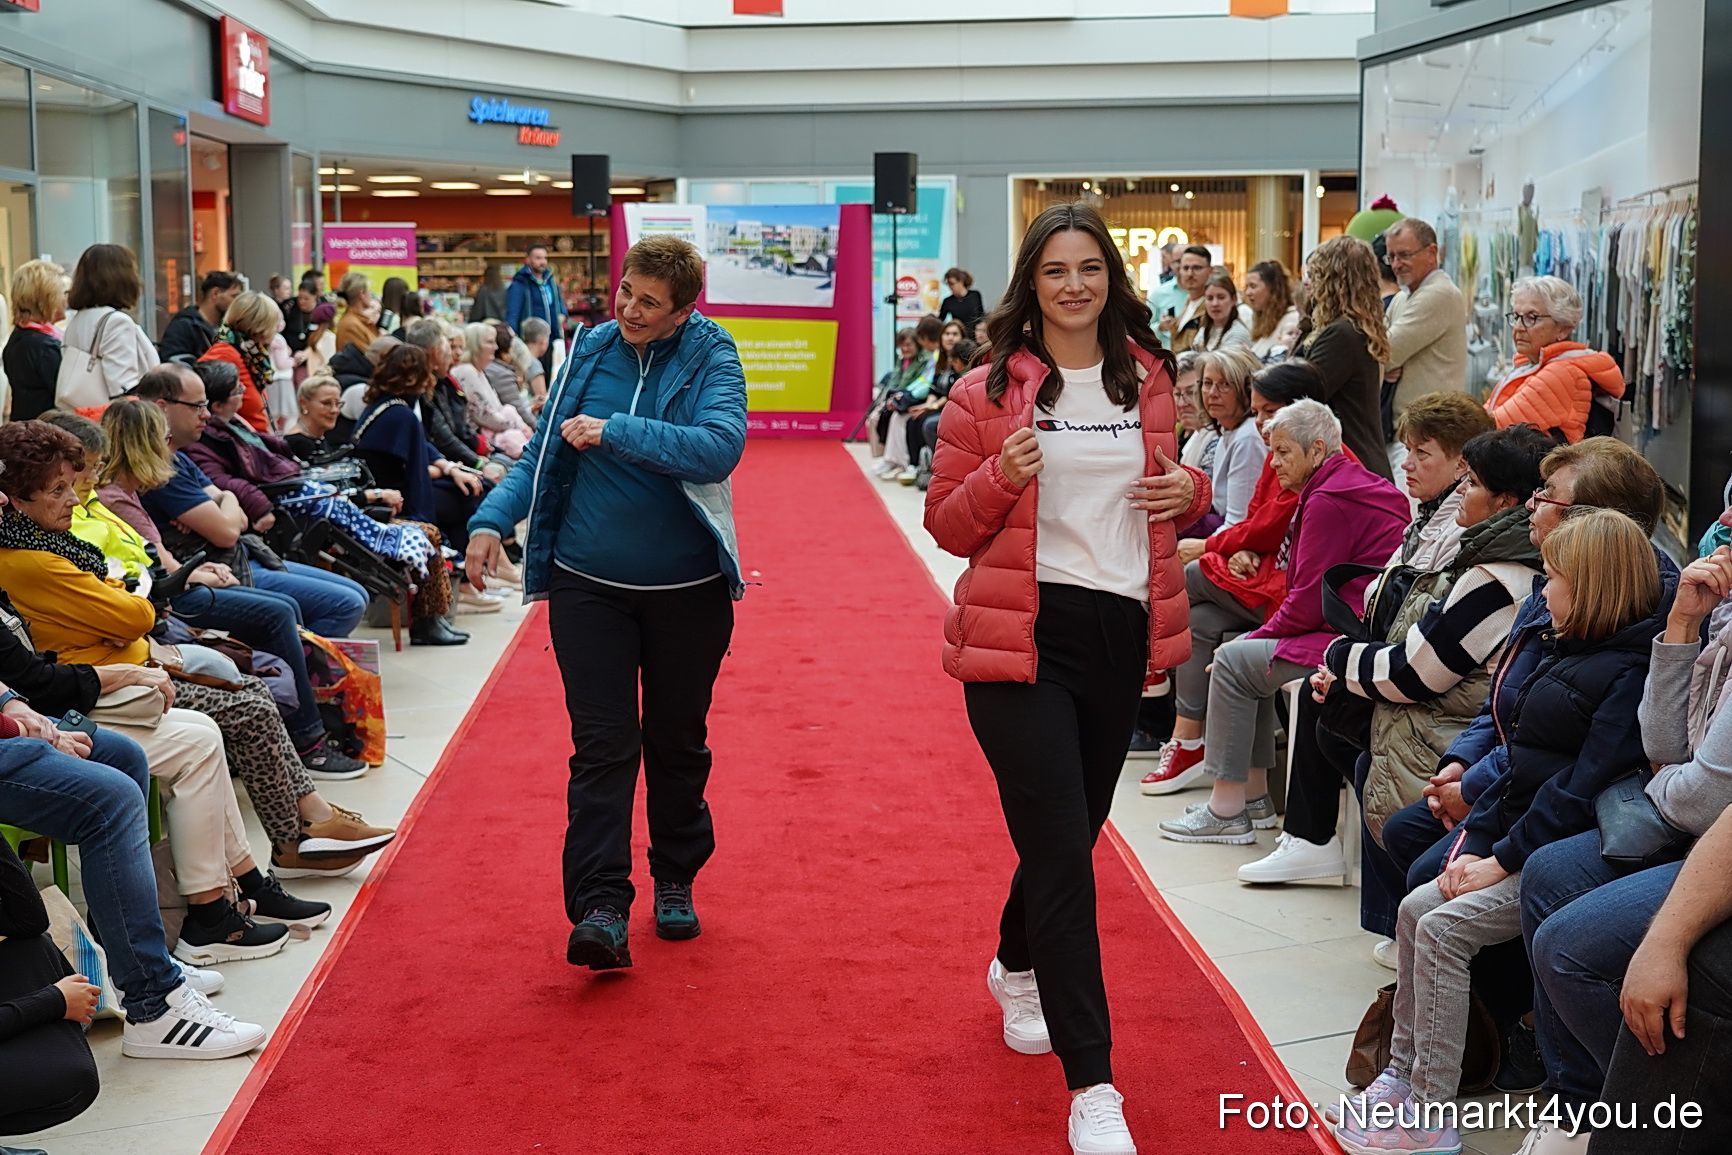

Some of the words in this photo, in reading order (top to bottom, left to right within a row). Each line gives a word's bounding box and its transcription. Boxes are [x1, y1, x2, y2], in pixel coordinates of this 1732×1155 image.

[469, 97, 549, 124] Spielwaren
[328, 238, 390, 249] Verschenken
[391, 238, 407, 249] Sie
[348, 249, 408, 260] Gutscheine!
[747, 351, 782, 360] Workout
[784, 351, 816, 360] machen
